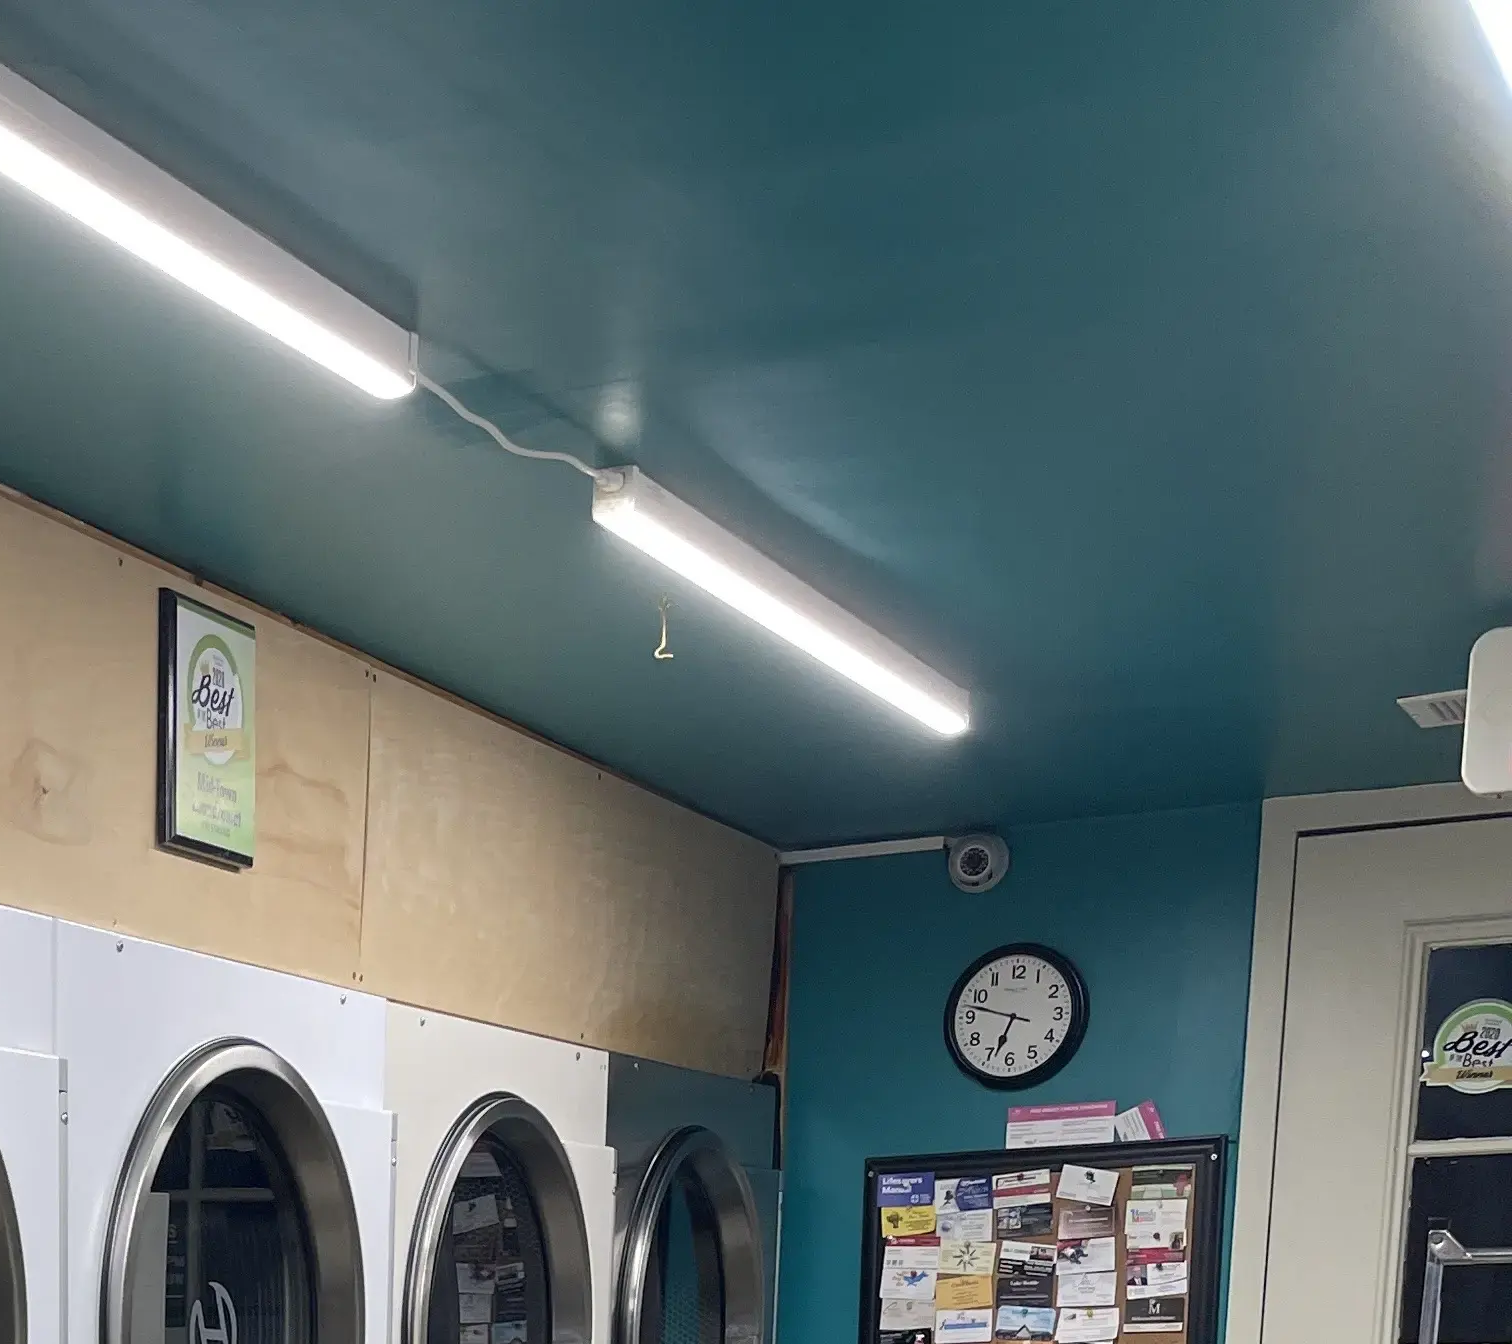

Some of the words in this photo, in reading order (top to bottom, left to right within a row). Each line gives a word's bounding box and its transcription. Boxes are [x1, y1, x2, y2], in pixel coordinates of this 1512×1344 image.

[192, 674, 235, 717] Best
[991, 972, 999, 987] 11
[1012, 965, 1027, 980] 12
[973, 989, 988, 1003] 10
[1048, 985, 1059, 998] 2
[966, 1011, 975, 1024] 9
[1053, 1007, 1063, 1021] 3
[970, 1032, 980, 1046] 8
[1044, 1028, 1055, 1043] 4
[1027, 1045, 1037, 1059] 5
[1442, 1031, 1512, 1059] Best
[985, 1048, 995, 1062] 7
[1004, 1052, 1015, 1066] 6
